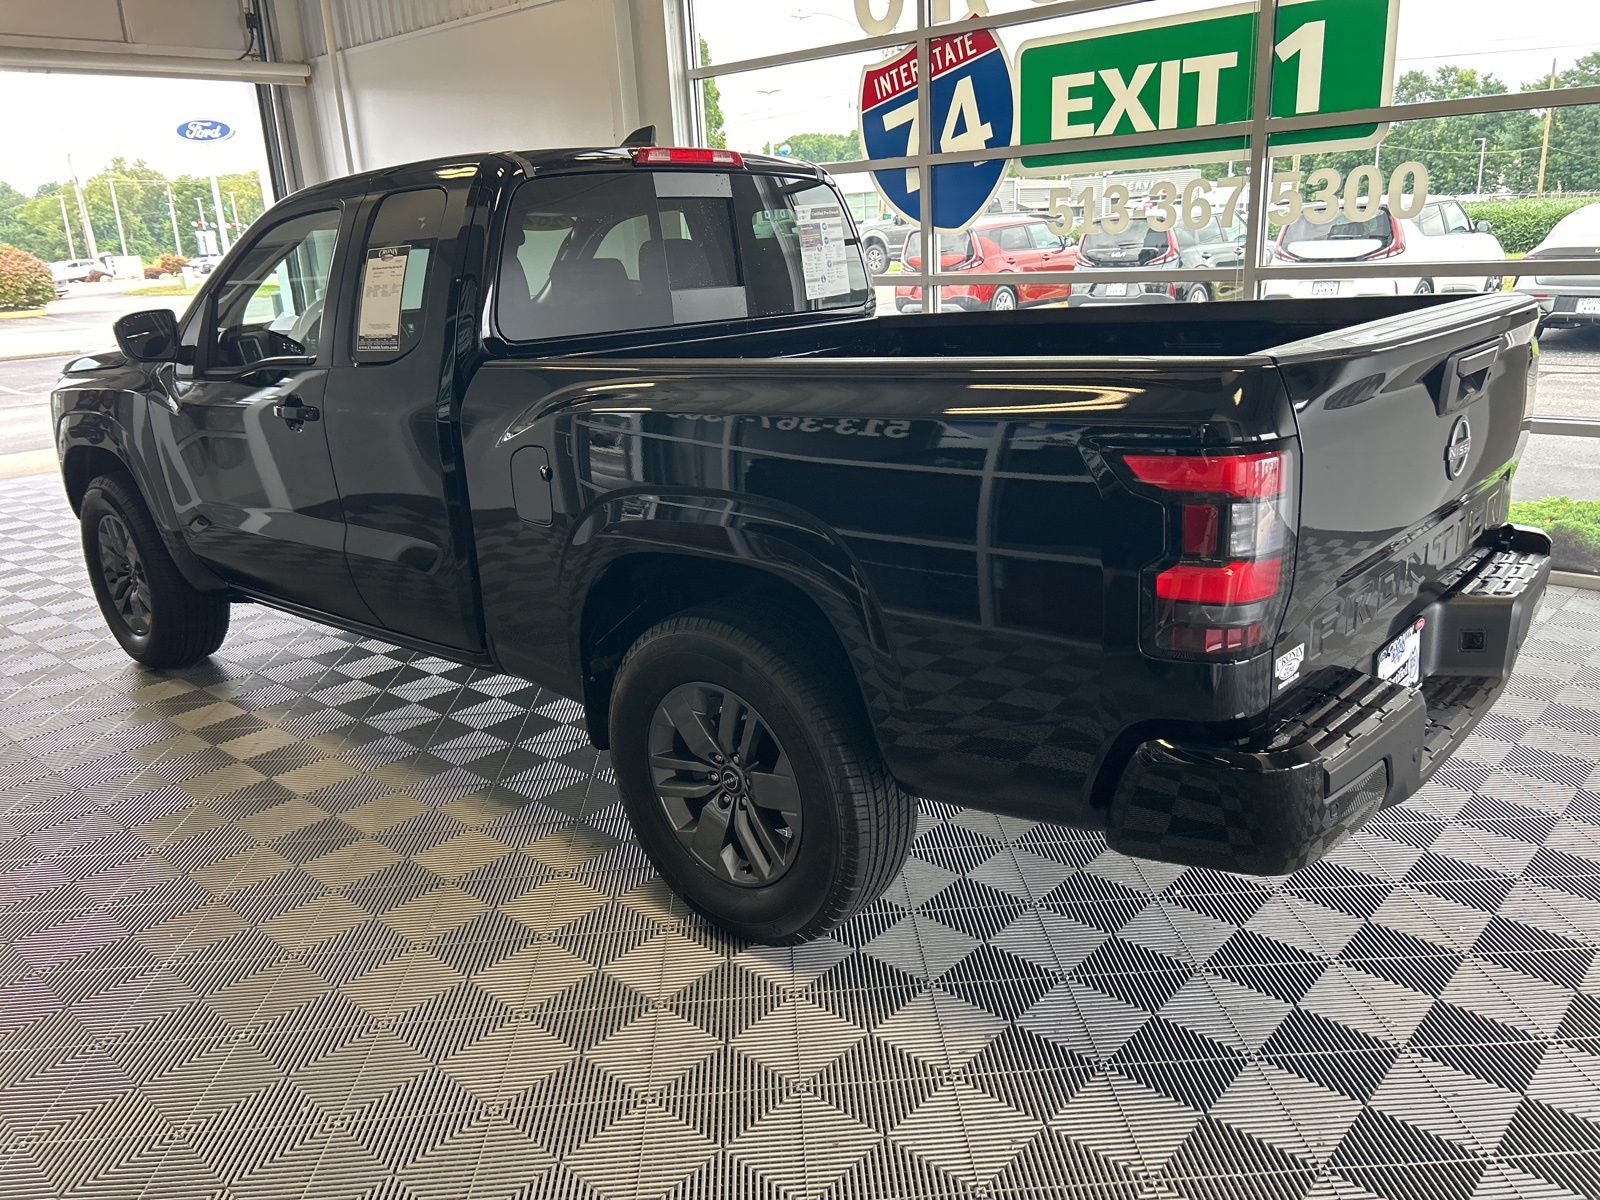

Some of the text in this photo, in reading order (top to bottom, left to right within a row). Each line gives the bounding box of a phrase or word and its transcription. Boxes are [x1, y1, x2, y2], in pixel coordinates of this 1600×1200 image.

[873, 31, 977, 100] INTERTATE
[1051, 19, 1326, 141] EXIT 1
[185, 121, 221, 139] Ford
[881, 75, 994, 194] 74
[1309, 487, 1501, 660] FRONTIER
